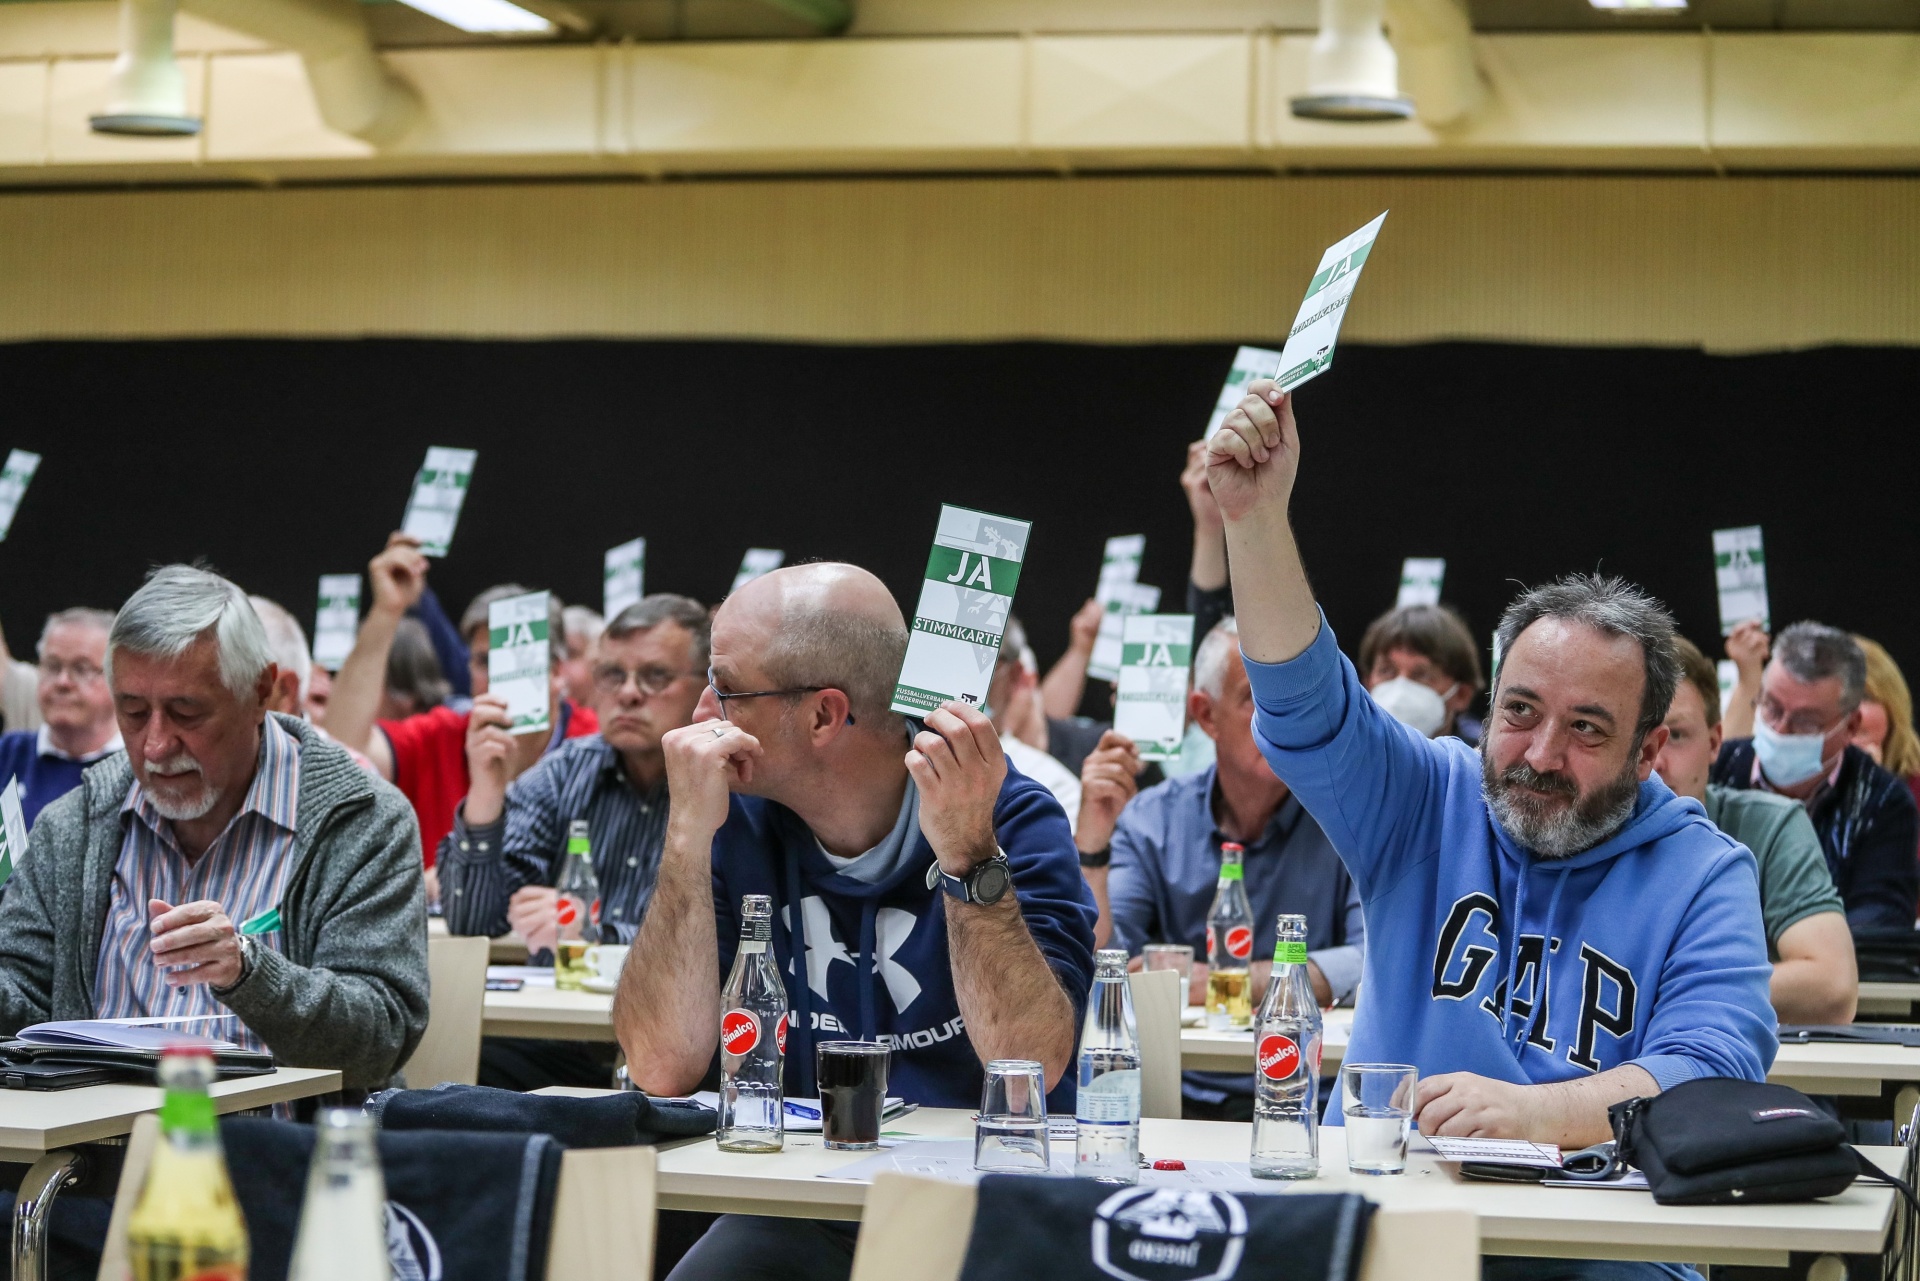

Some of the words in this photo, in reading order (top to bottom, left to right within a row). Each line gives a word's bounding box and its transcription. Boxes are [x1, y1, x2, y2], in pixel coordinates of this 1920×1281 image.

[1319, 253, 1351, 290] JA
[946, 552, 992, 590] JA
[502, 622, 536, 648] JA
[913, 617, 1002, 648] STIMMKARTE
[1136, 643, 1173, 667] JA
[894, 693, 933, 707] NIEDERRHEIN
[1431, 891, 1638, 1074] GAP
[723, 1021, 754, 1047] Sinalco
[1260, 1045, 1296, 1071] Sinalco
